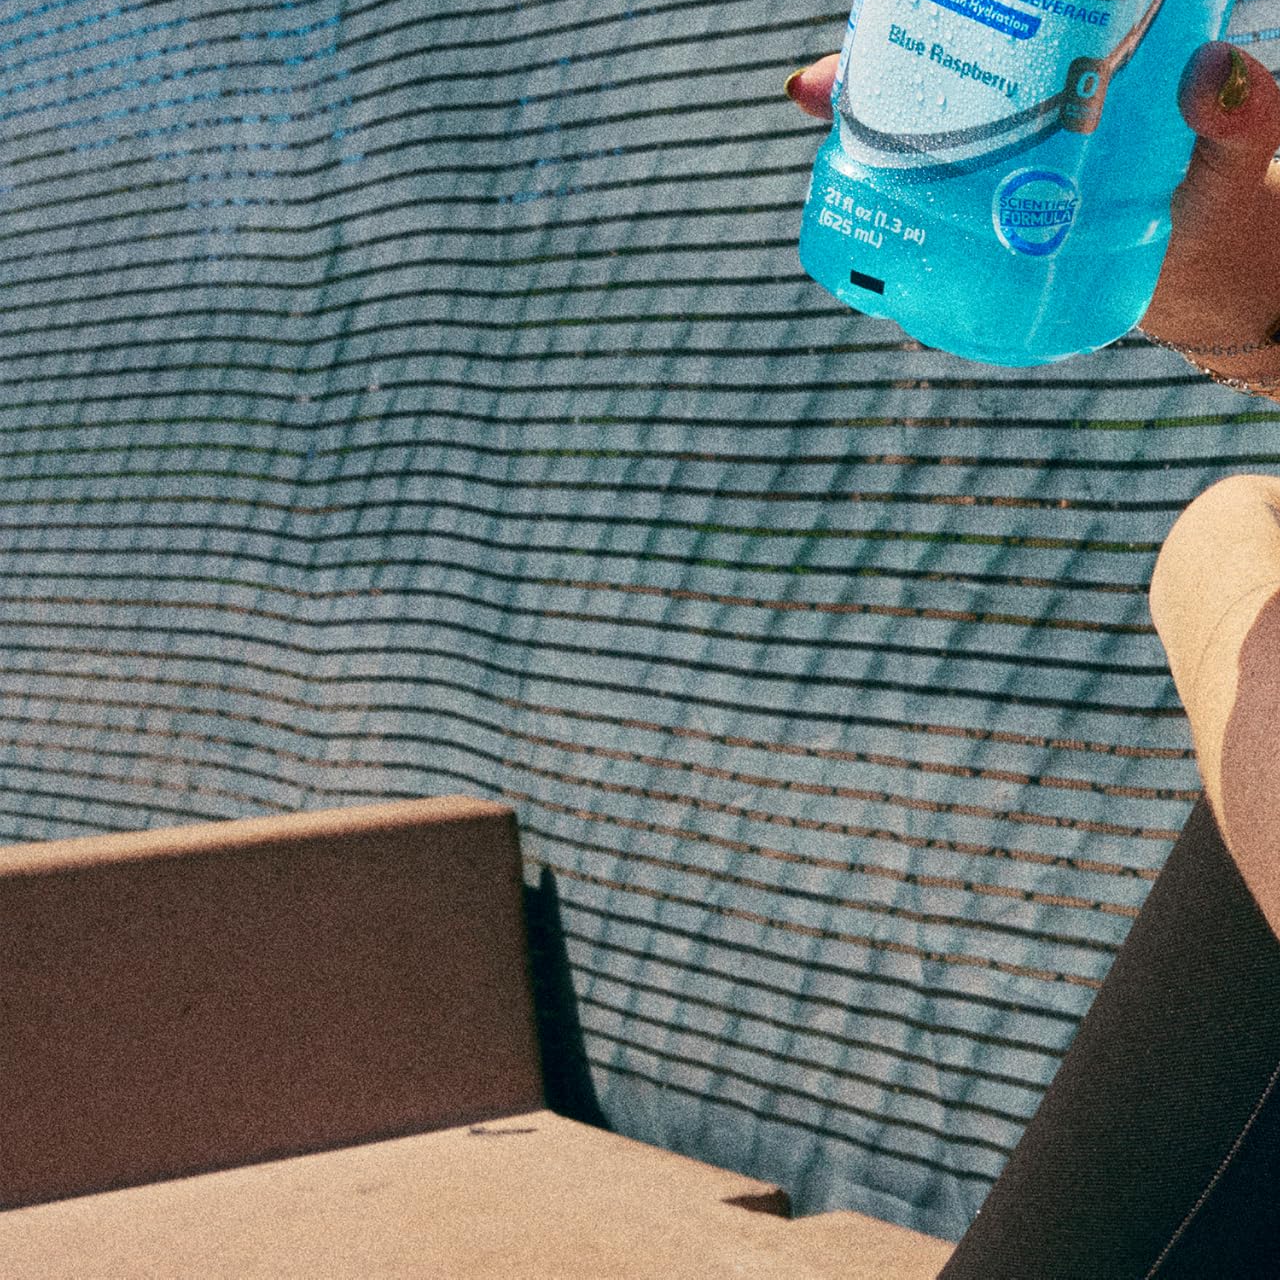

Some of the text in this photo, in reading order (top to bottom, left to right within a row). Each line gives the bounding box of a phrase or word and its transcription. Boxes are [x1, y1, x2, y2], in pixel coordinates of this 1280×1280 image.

[888, 23, 1019, 99] Blue Raspberry
[824, 188, 842, 206] 21
[855, 206, 872, 222] oz
[873, 209, 903, 233] (1.3
[903, 227, 926, 245] pt)
[999, 195, 1080, 210] SCIENTIFIC
[1000, 209, 1074, 226] FORMULA
[817, 207, 884, 250] (625 mL)
